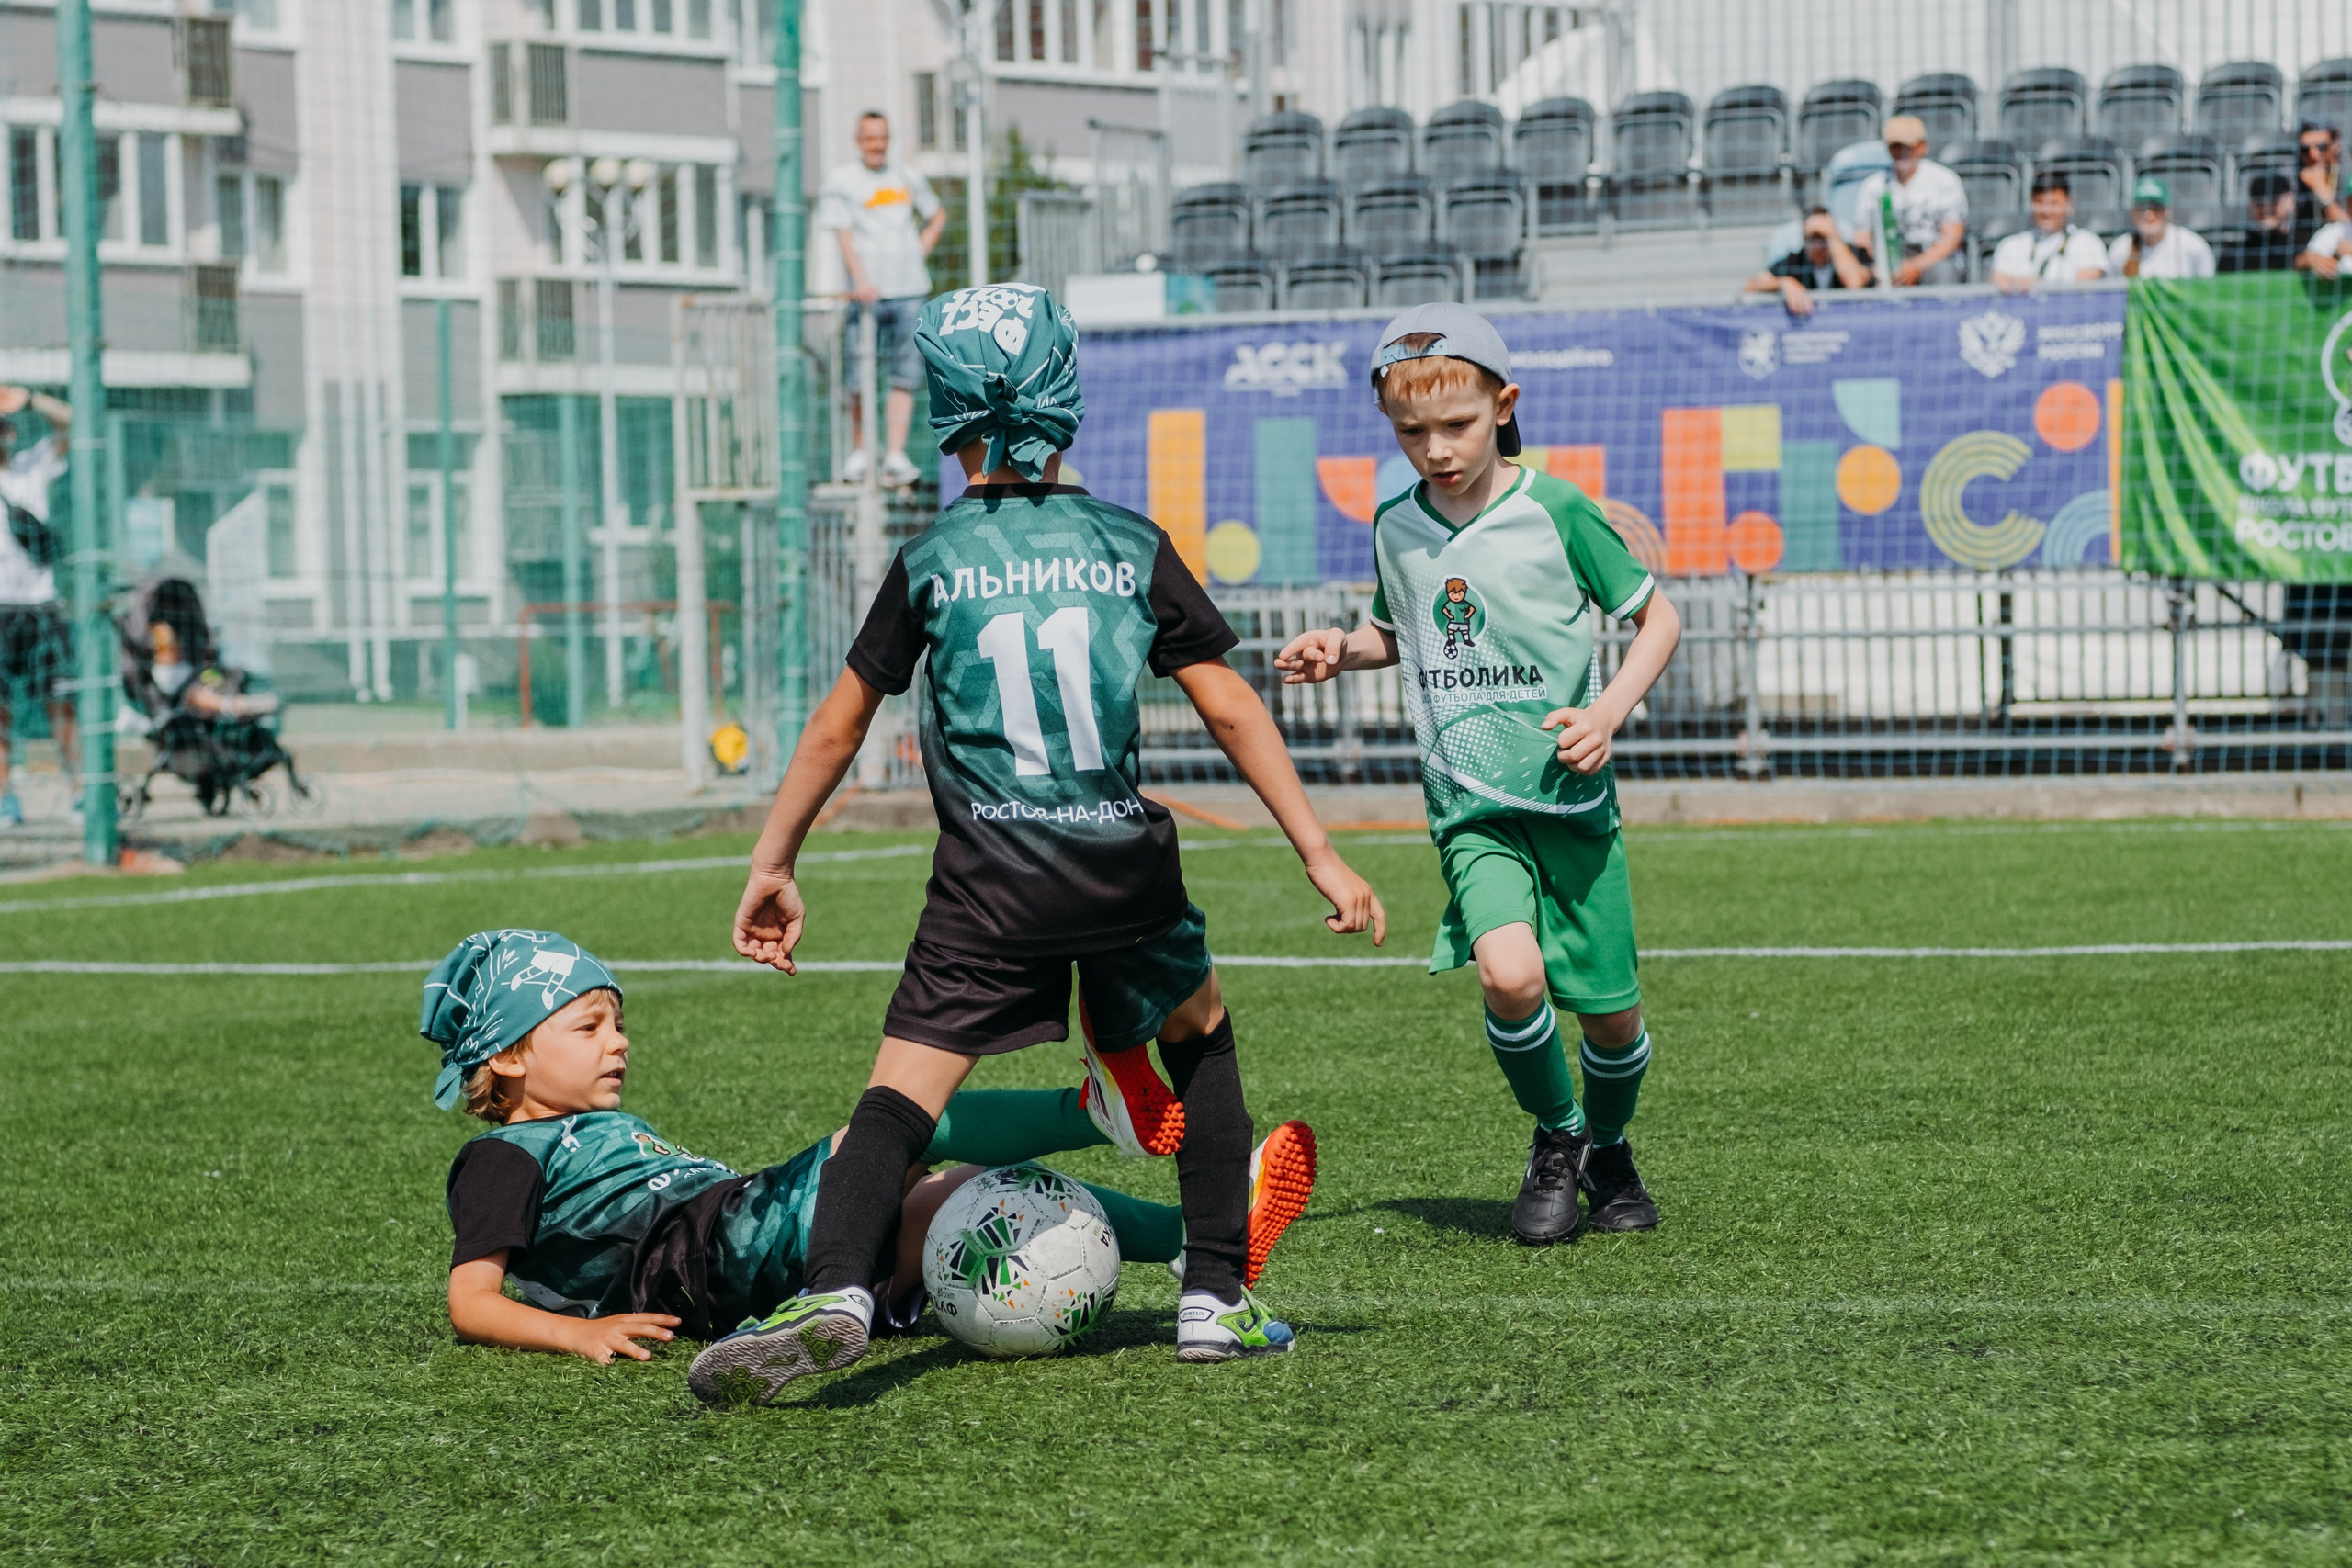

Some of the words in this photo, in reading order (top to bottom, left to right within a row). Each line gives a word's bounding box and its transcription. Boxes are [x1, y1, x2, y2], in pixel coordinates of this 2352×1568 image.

[931, 558, 1136, 608] АЛЬНИКОВ
[977, 606, 1105, 776] 11
[1419, 665, 1544, 691] ФТБОЛИКА
[1433, 693, 1483, 704] ФУТБОЛА
[1486, 690, 1507, 702] ДЛЯ
[1510, 686, 1546, 701] ДЕТЕЙ
[971, 798, 1144, 824] РОСТОВ-НА-ДОН
